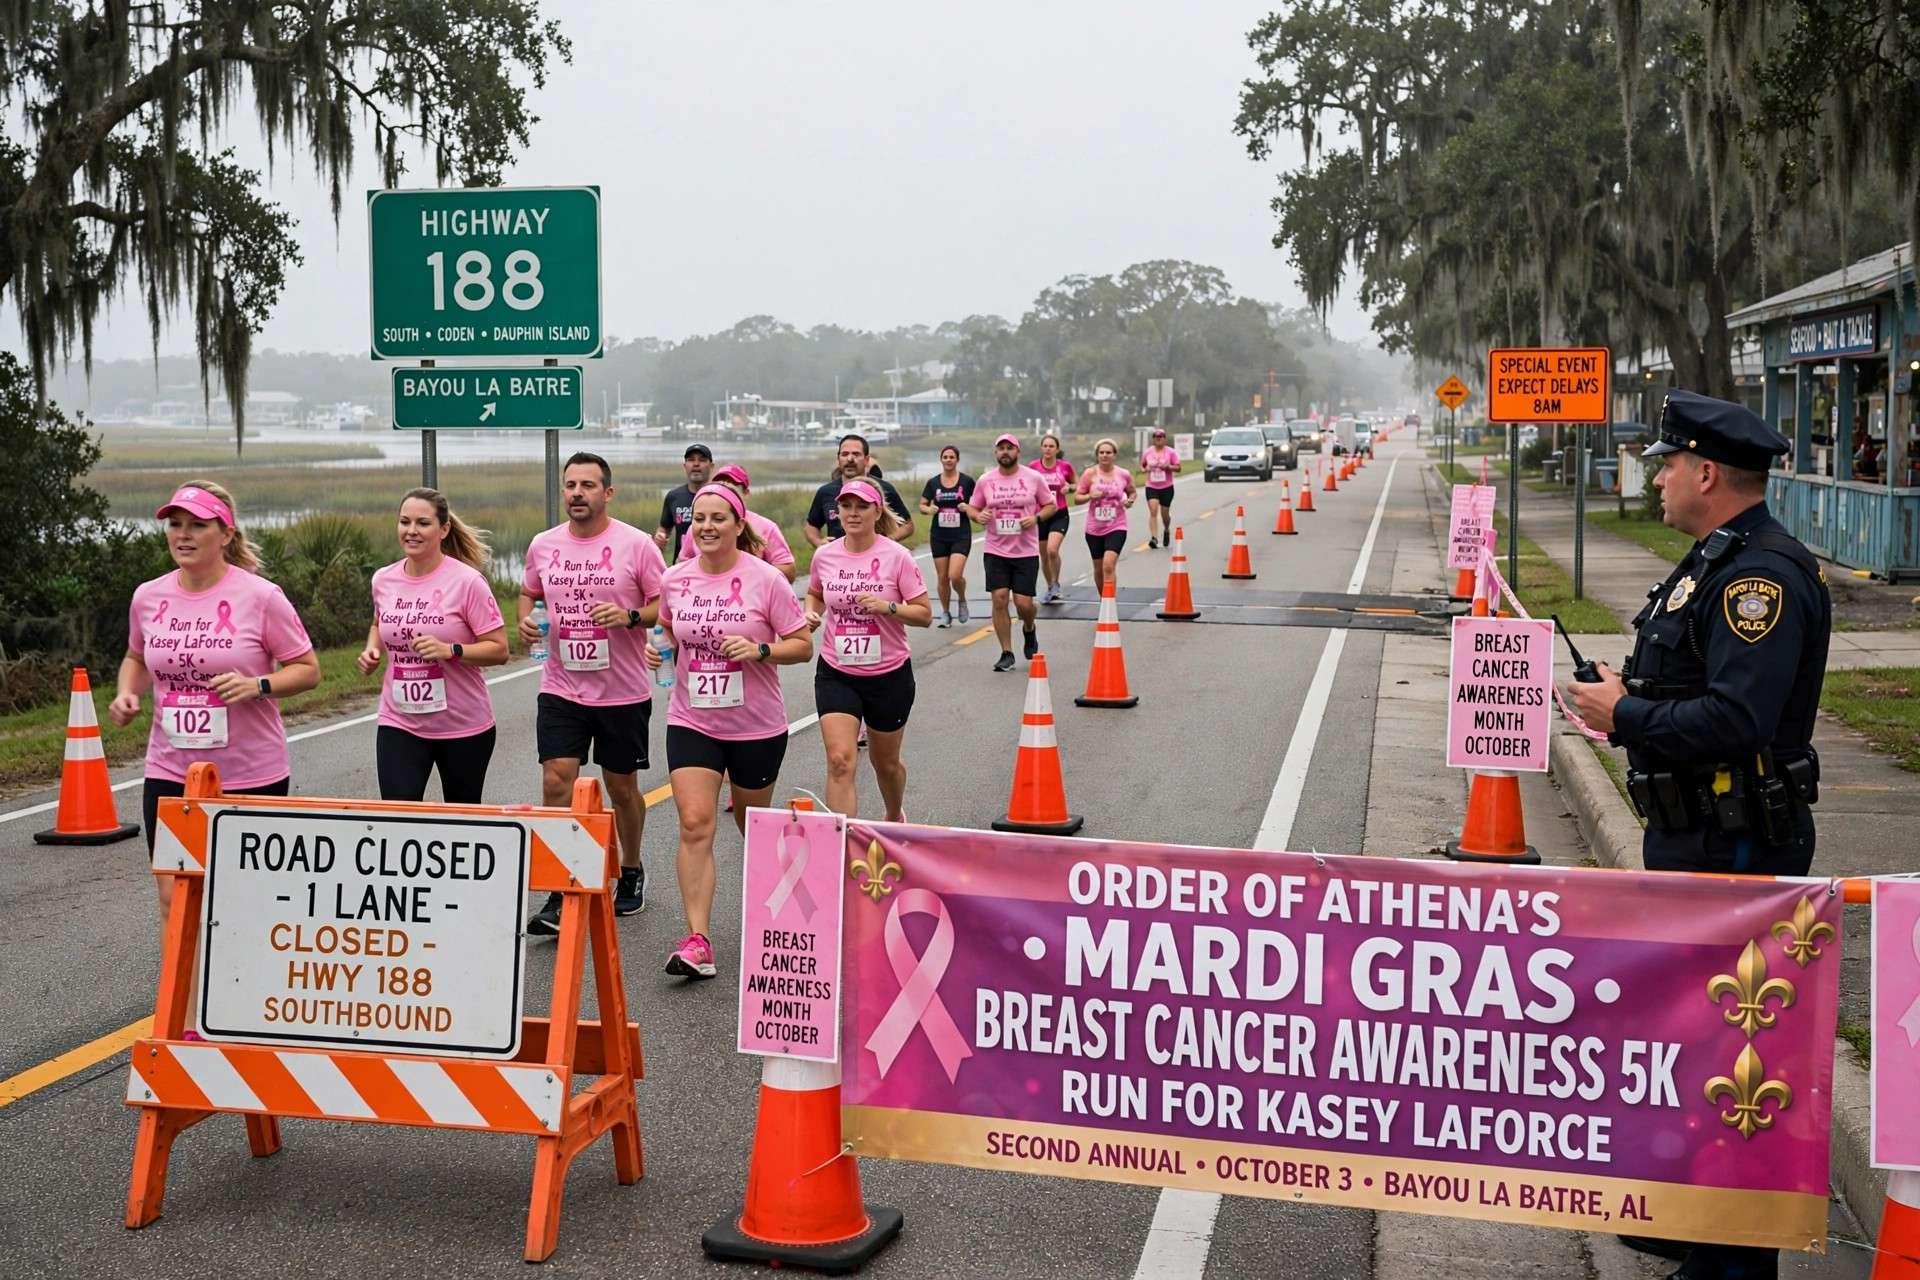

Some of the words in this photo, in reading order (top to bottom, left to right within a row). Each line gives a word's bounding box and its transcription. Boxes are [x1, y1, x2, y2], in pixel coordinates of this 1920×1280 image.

[421, 208, 550, 237] HIGHWAY
[426, 249, 544, 311] 188
[383, 327, 419, 342] SOUTH
[437, 327, 475, 341] CODEN
[493, 326, 543, 341] DAUPHIN
[549, 326, 590, 341] ISLAND
[1500, 357, 1552, 374] SPECIAL
[1558, 357, 1597, 373] EVENT
[403, 378, 465, 397] BAYOU
[475, 378, 500, 396] LA
[510, 377, 571, 396] BATRE
[1498, 378, 1545, 394] EXPECT
[1551, 378, 1599, 394] DELAYS
[1533, 399, 1561, 414] 8AM
[564, 560, 582, 571] Run
[585, 560, 599, 571] for
[839, 569, 854, 580] Run
[548, 574, 574, 587] Kasey
[578, 573, 615, 586] LaForce
[850, 582, 883, 593] LaForce
[395, 598, 413, 610] Run
[415, 597, 429, 610] for
[573, 589, 587, 601] 5K
[693, 596, 712, 607] Run
[715, 595, 729, 607] for
[555, 602, 579, 614] Breast
[676, 610, 702, 625] Kasey
[706, 610, 746, 622] LaForce
[169, 618, 192, 632] Run
[195, 618, 214, 632] for
[405, 612, 445, 625] LaForce
[1737, 620, 1767, 630] POLICE
[401, 628, 414, 640] 5K
[701, 625, 714, 638] 5K
[149, 635, 180, 652] Kasey
[184, 635, 233, 650] LaForce
[568, 642, 598, 660] 102
[843, 637, 871, 654] 217
[1475, 633, 1530, 654] BREAST
[178, 654, 196, 668] 5K
[1472, 659, 1530, 680] CANCER
[401, 681, 434, 702] 102
[697, 675, 730, 695] 217
[1457, 684, 1544, 706] AWARENESS
[173, 709, 211, 734] 102
[1474, 711, 1524, 732] MONTH
[1465, 736, 1531, 757] OCTOBER
[239, 832, 336, 873] ROAD
[355, 837, 496, 880] CLOSED
[307, 882, 316, 917] 1
[336, 883, 432, 923] LANE
[1068, 861, 1229, 914] ORDER
[1243, 873, 1306, 919] OF
[1317, 878, 1560, 936] ATHENA'S
[270, 922, 409, 957] CLOSED
[763, 930, 816, 952] BREAST
[761, 953, 817, 975] CANCER
[1065, 915, 1324, 1005] MARDI
[1351, 936, 1575, 1024] GRAS
[287, 960, 363, 993] HWY
[377, 965, 433, 997] 188
[748, 974, 831, 1000] AWARENESS
[264, 996, 452, 1032] SOUTHBOUND
[762, 999, 812, 1021] MONTH
[755, 1020, 819, 1045] OCTOBER
[975, 987, 1132, 1061] BREAST
[1145, 1003, 1317, 1078] CANCER
[1329, 1018, 1605, 1101] AWARENESS
[1619, 1039, 1682, 1108] 5K
[1062, 1070, 1147, 1121] RUN
[1162, 1079, 1244, 1130] FOR
[1257, 1088, 1400, 1143] KASEY
[1413, 1102, 1612, 1163] LAFORCE
[987, 1131, 1080, 1163] SECOND
[1088, 1142, 1187, 1175] ANNUAL
[1216, 1155, 1330, 1189] OCTOBER
[1338, 1167, 1352, 1191] 3
[1384, 1171, 1470, 1203] BAYOU
[1479, 1179, 1511, 1207] LA
[1519, 1184, 1611, 1222] BATRE,
[1619, 1194, 1653, 1222] AL
